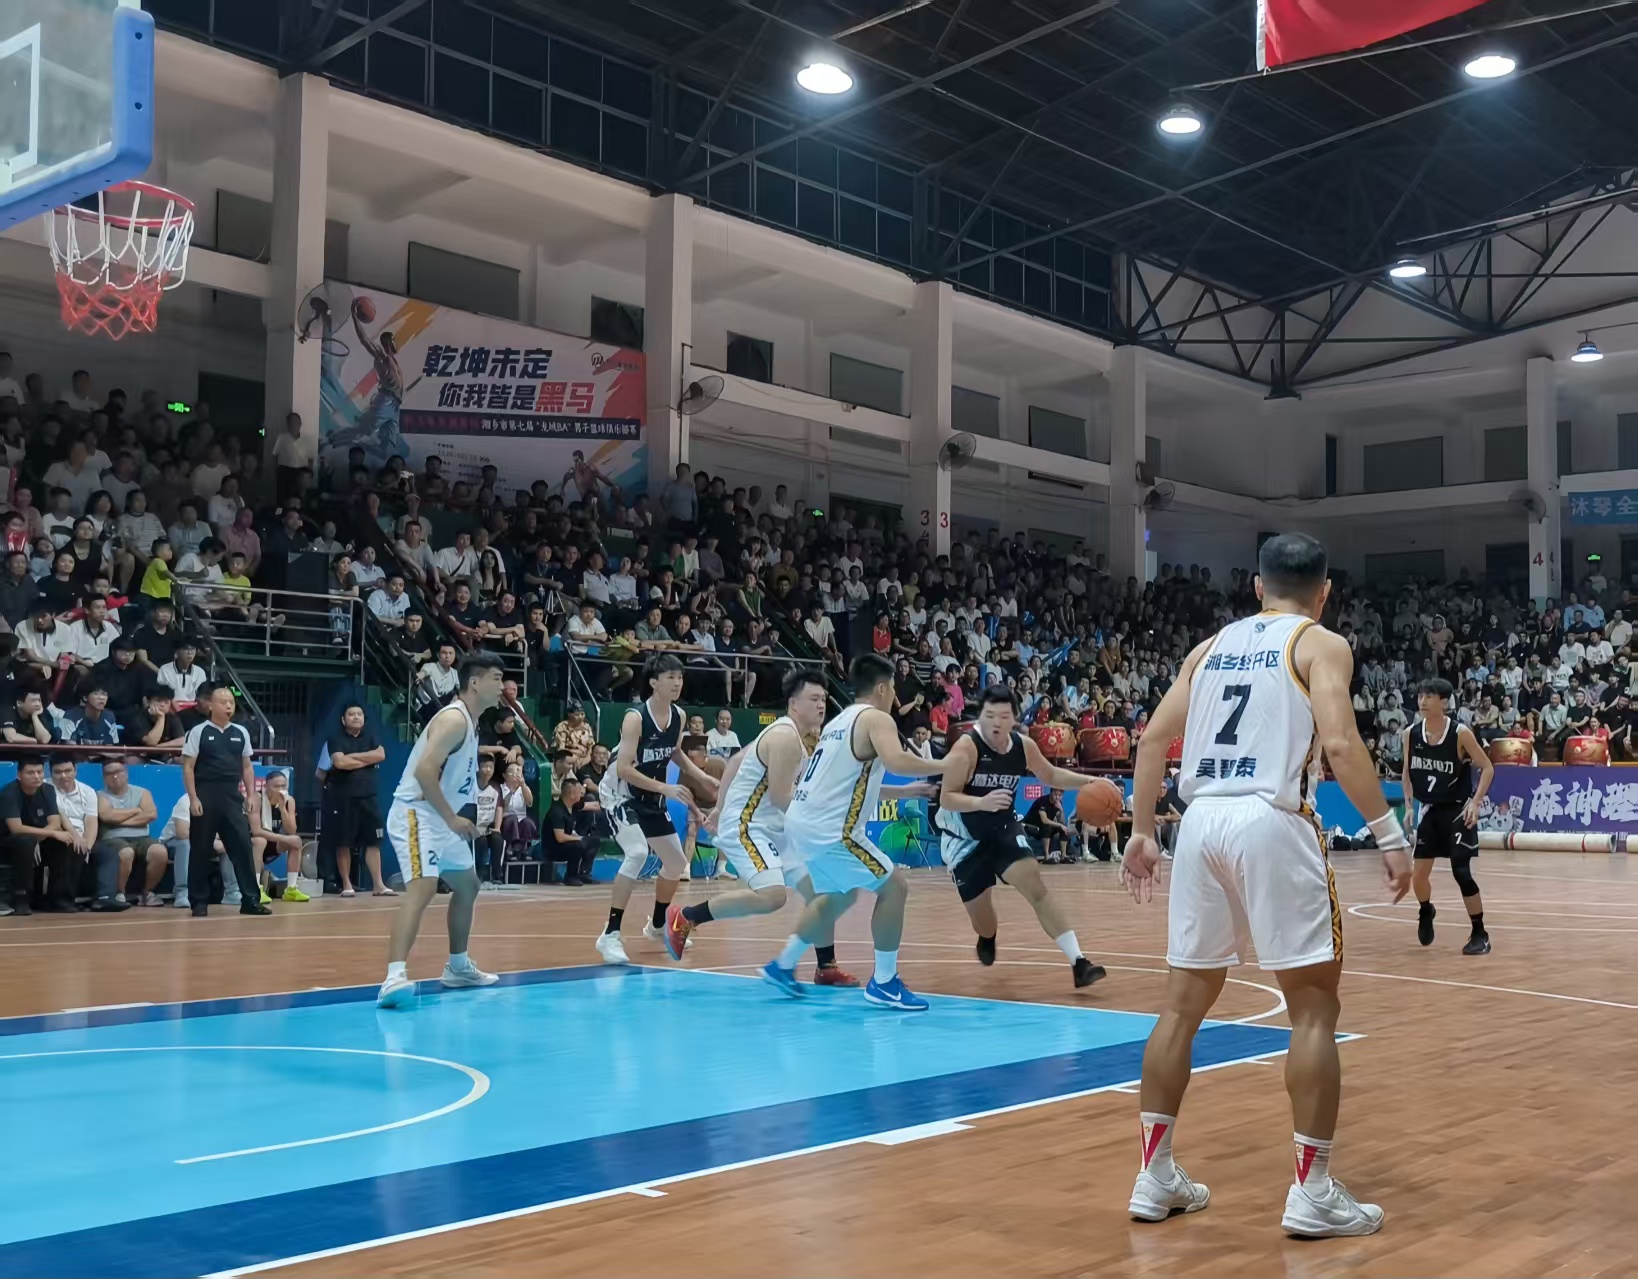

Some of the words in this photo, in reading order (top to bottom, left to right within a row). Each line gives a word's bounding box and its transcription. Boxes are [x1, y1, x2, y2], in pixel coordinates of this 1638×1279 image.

[422, 345, 553, 379] 乾坤未定
[438, 381, 595, 414] 你我皆是黑马
[920, 510, 930, 526] 3
[940, 511, 949, 529] 3
[1532, 551, 1544, 567] 4
[1214, 684, 1252, 746] 7
[643, 746, 677, 763] 腾达电
[1427, 775, 1437, 793] 7
[1454, 832, 1463, 845] 7
